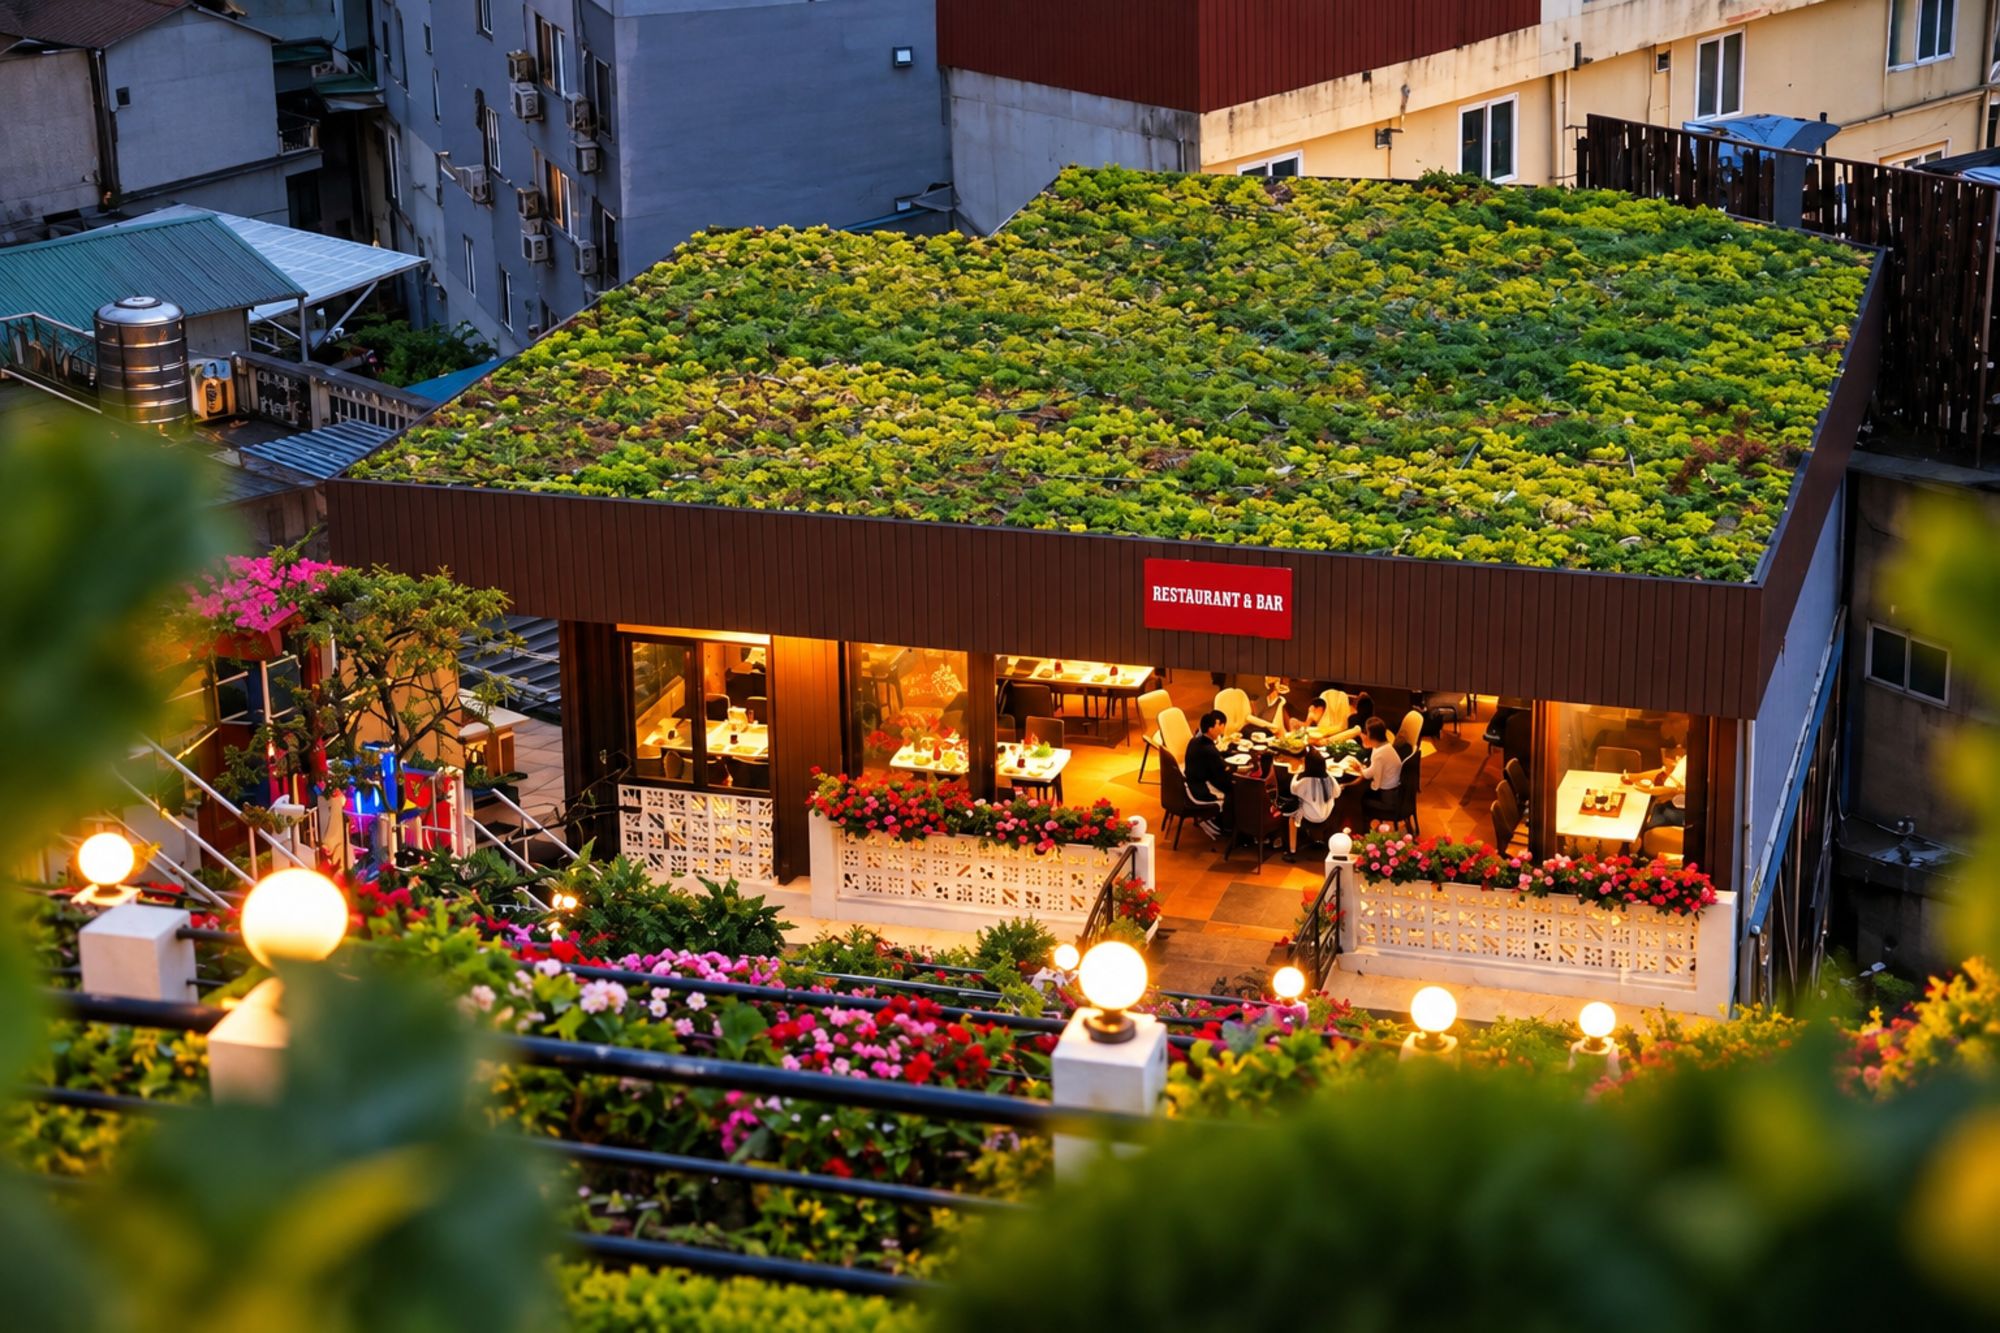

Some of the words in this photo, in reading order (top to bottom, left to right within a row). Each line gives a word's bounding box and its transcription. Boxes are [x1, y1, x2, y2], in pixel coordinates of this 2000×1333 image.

[1152, 585, 1241, 608] RESTAURANT
[1243, 593, 1252, 609] &
[1256, 594, 1283, 612] BAR
